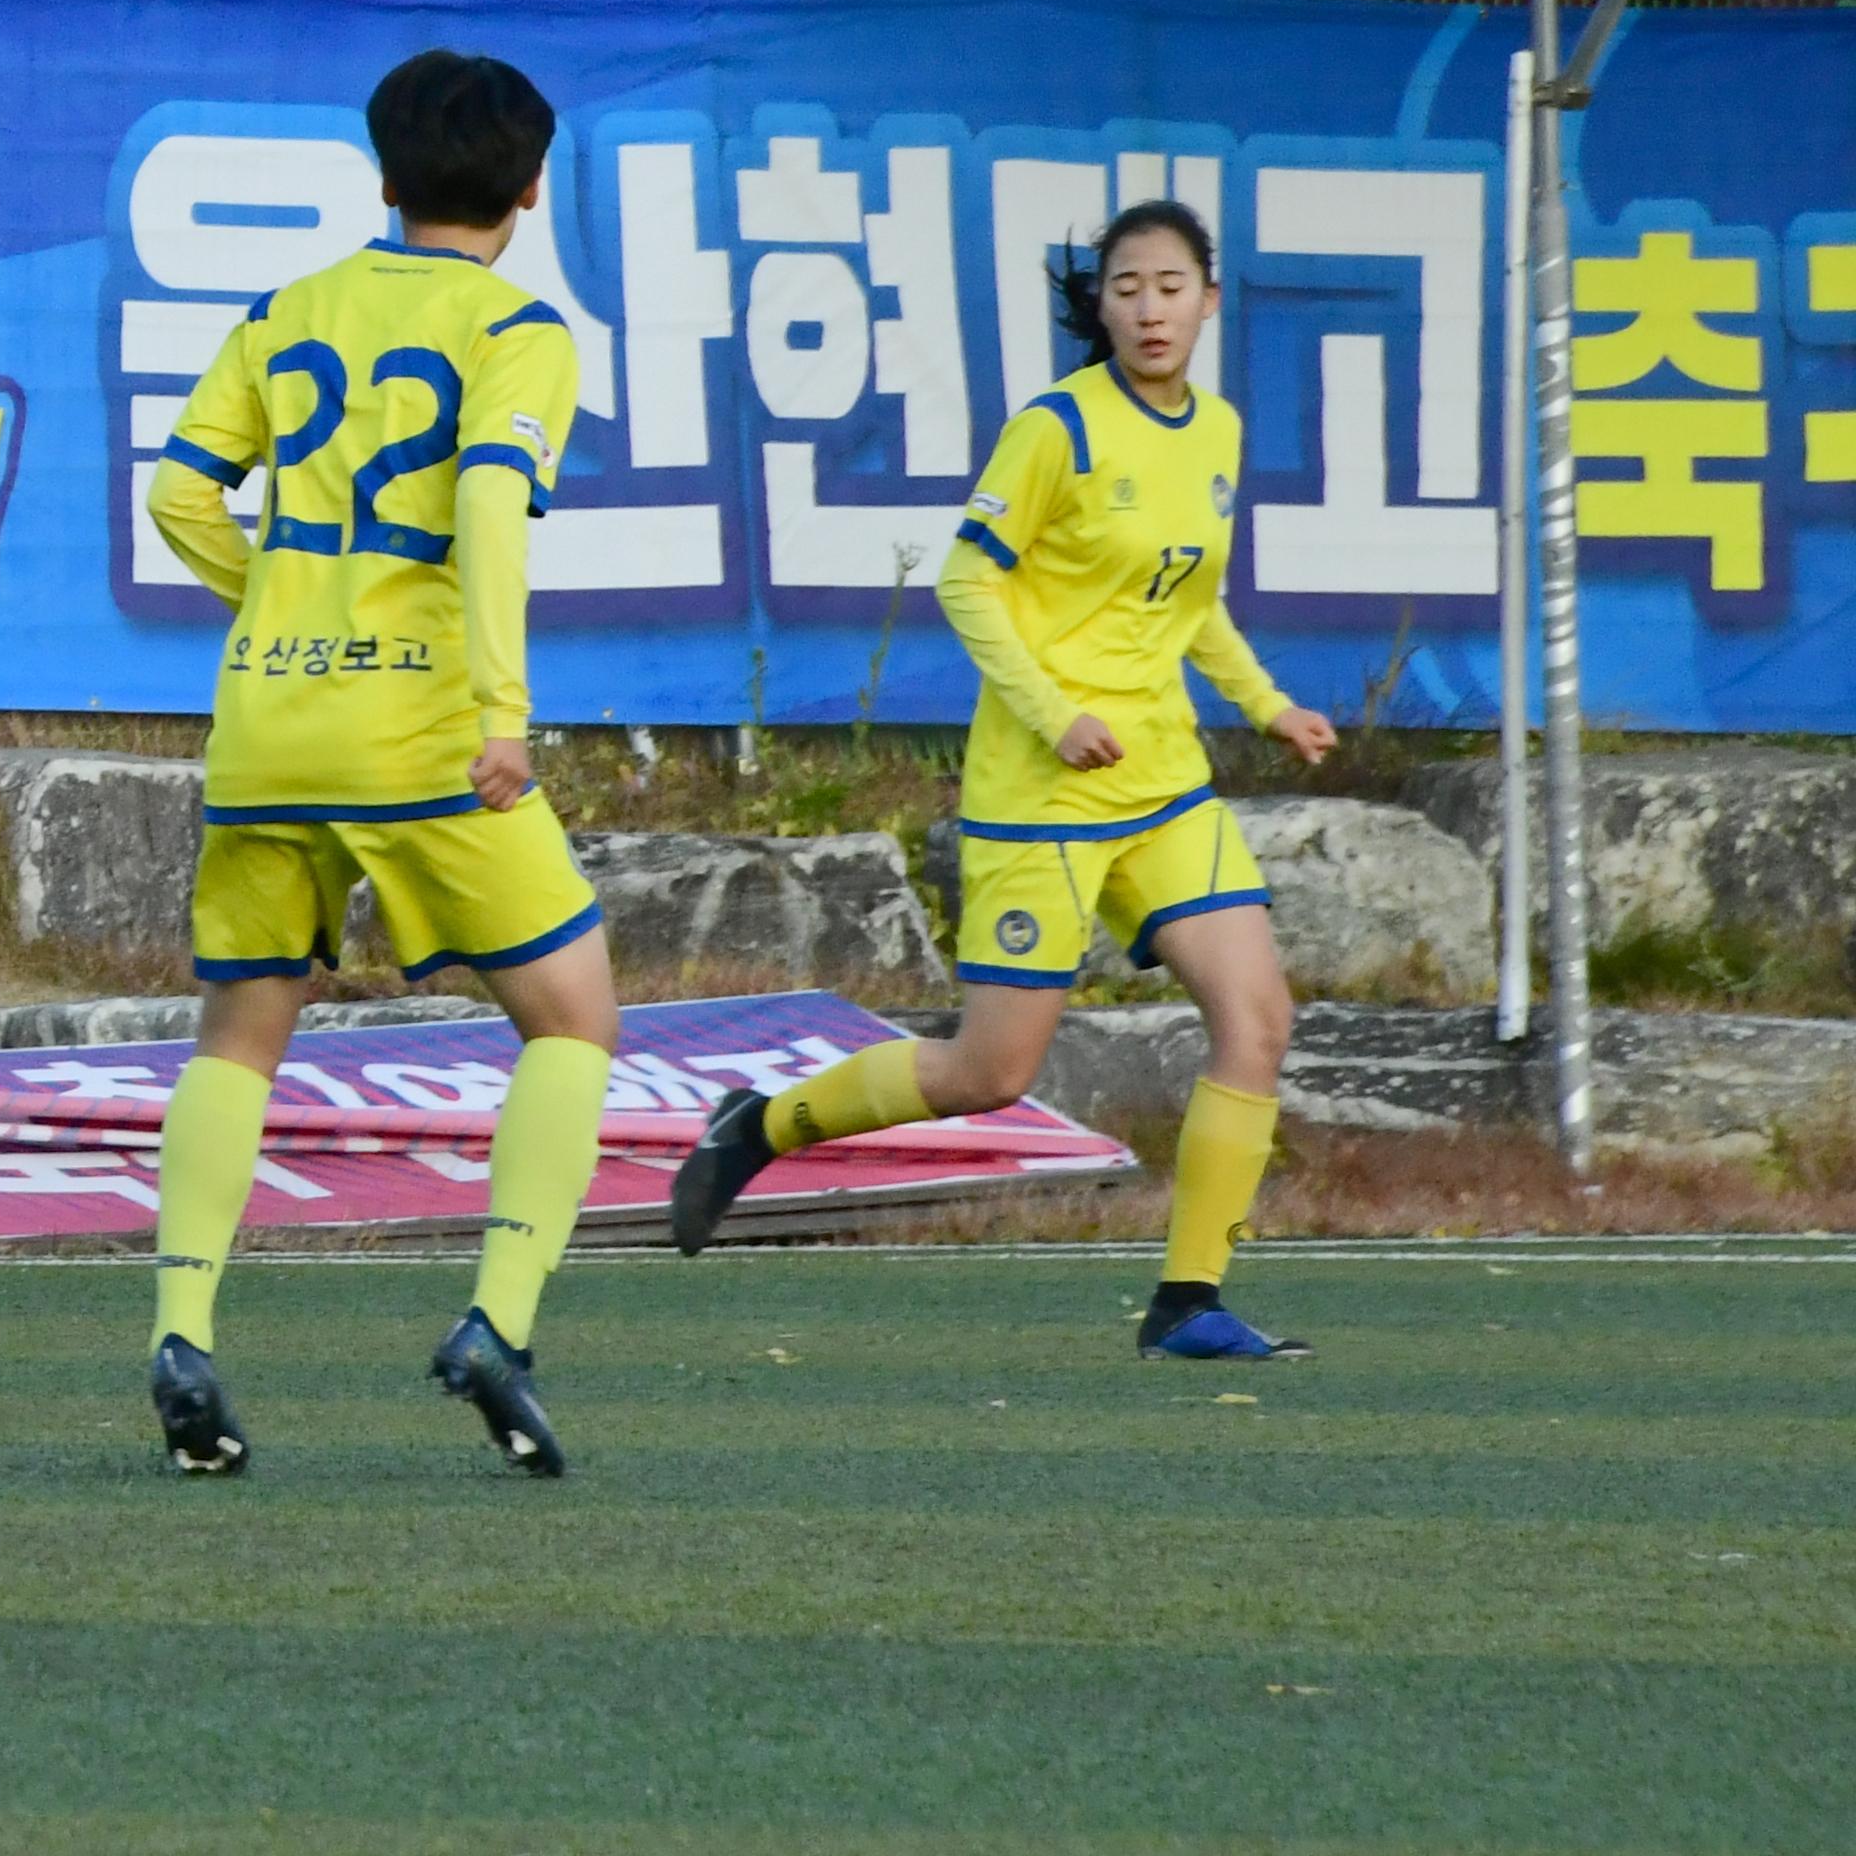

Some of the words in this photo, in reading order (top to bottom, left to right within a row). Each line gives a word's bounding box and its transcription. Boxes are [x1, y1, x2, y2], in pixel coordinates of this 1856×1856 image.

[265, 337, 464, 566] 22
[1570, 230, 1856, 593] 축
[1144, 545, 1204, 604] 17
[226, 636, 434, 677] 오산정보고
